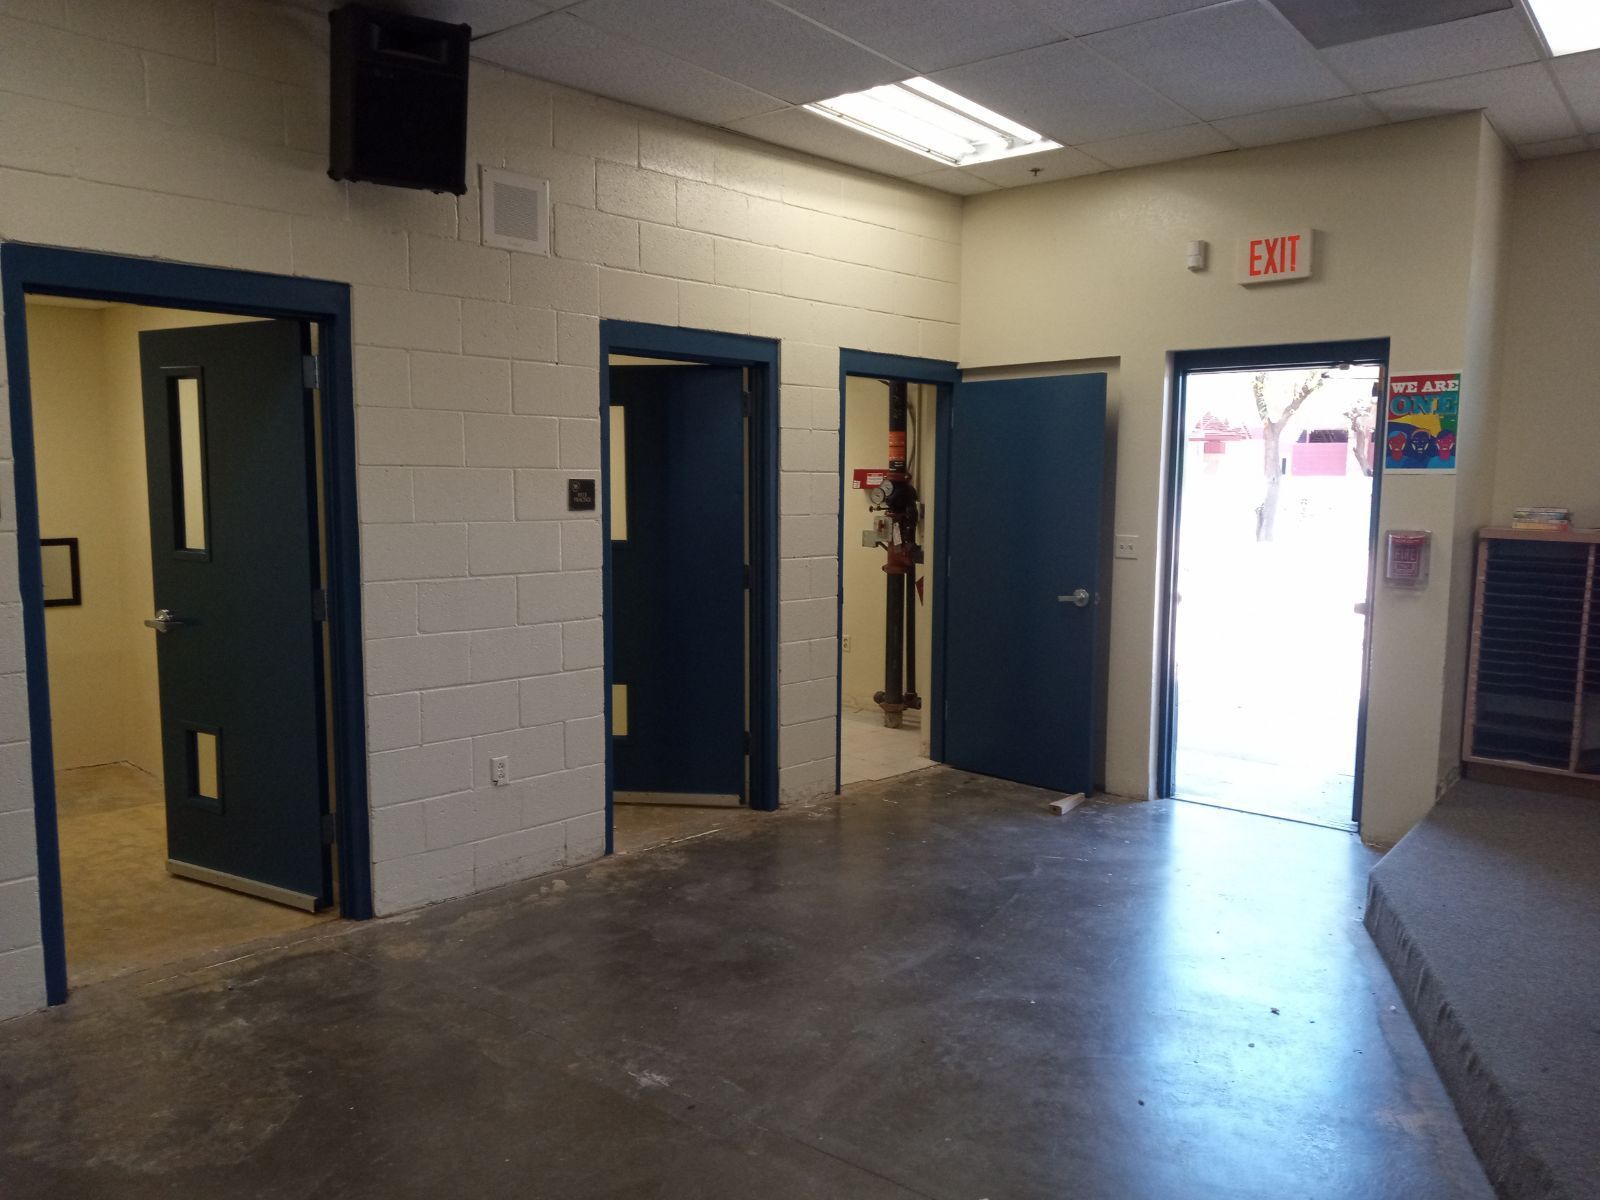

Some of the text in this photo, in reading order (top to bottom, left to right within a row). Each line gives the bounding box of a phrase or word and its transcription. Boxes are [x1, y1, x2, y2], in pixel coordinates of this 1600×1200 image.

[1249, 235, 1301, 276] EXIT
[1391, 379, 1459, 393] WE ARE
[1390, 394, 1458, 415] ONE
